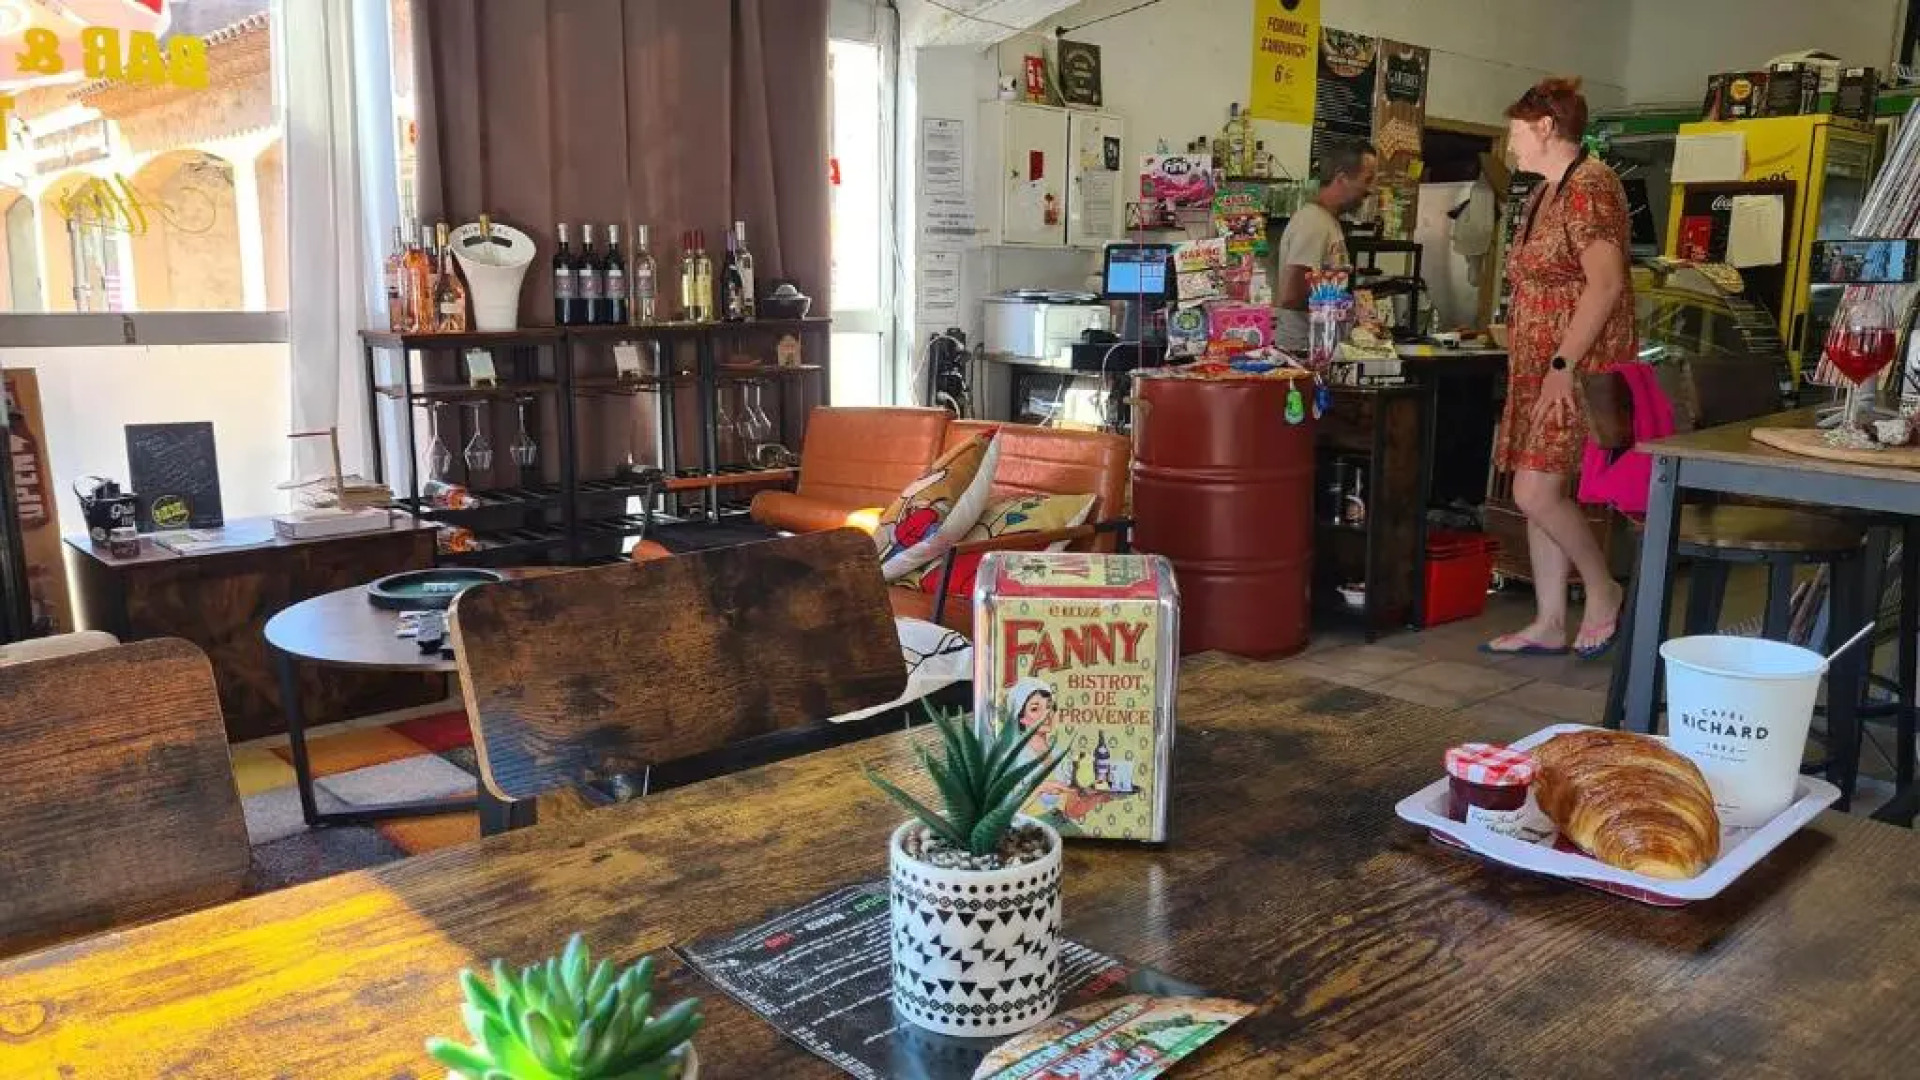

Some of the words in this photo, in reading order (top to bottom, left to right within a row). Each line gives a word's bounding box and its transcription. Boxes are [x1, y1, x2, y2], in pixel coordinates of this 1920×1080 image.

[1274, 63, 1284, 83] 6
[1003, 617, 1149, 688] FANNY
[1068, 674, 1144, 690] BISTROT
[1094, 691, 1117, 706] DE
[1058, 708, 1151, 725] PROVENCE
[1681, 713, 1769, 740] RICHARD
